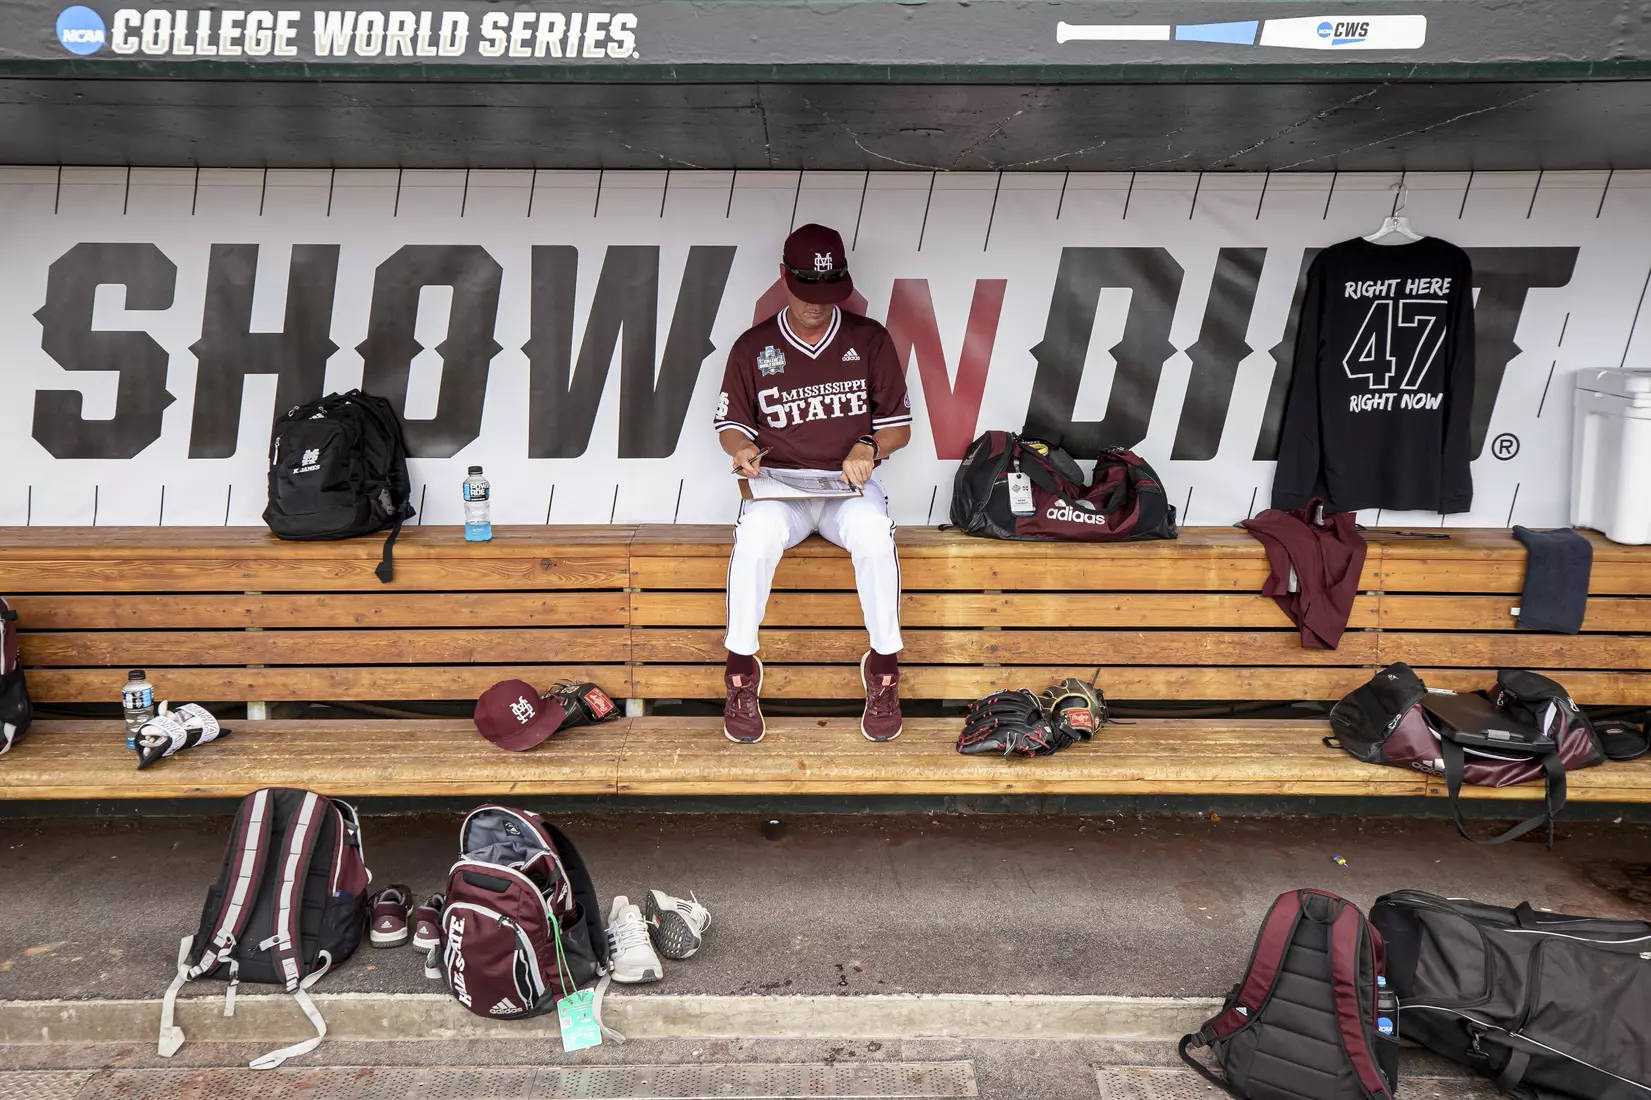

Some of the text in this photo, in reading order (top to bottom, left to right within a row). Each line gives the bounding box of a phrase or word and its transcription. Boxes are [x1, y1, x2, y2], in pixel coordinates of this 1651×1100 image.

[62, 29, 105, 43] NCAA
[111, 9, 301, 55] COLLEGE
[313, 11, 469, 56] WORLD
[1334, 22, 1370, 37] CWS
[1344, 278, 1452, 300] RIGHT HERE
[32, 242, 1580, 461] SHOW N DIT
[1342, 299, 1448, 390] 47
[781, 378, 867, 403] MISSISSIPPI
[1349, 393, 1444, 413] RIGHT NOW
[758, 386, 867, 429] STATE
[449, 915, 466, 971] SATE
[489, 1007, 523, 1015] adidas
